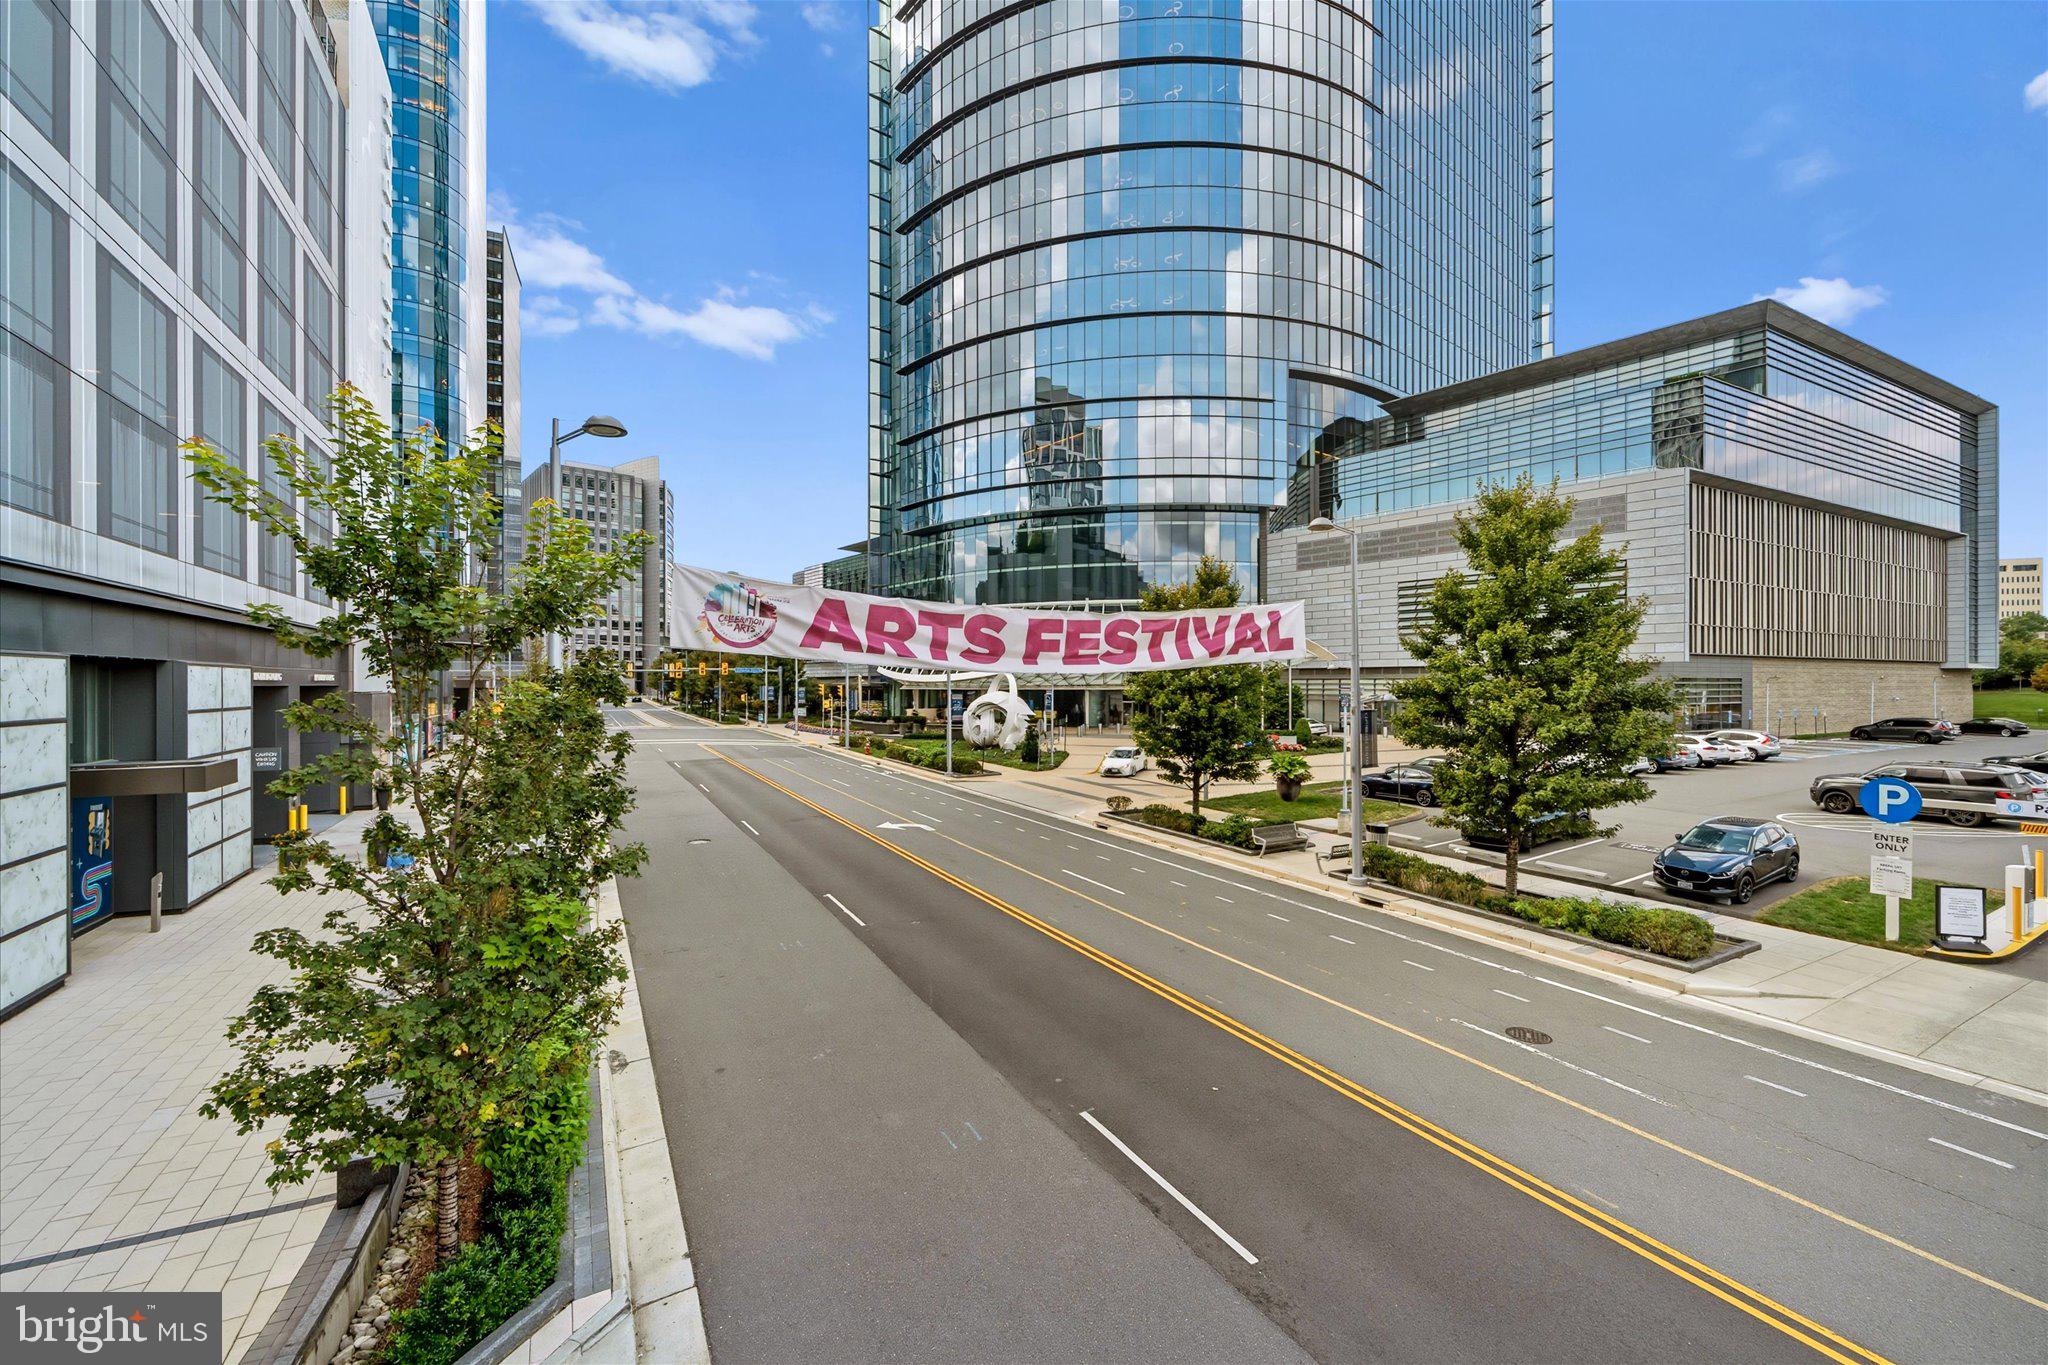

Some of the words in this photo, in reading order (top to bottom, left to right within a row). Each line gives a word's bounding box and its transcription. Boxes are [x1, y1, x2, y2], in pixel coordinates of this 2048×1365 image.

[733, 623, 756, 633] ARTS
[799, 598, 1007, 665] ARTS
[1022, 610, 1294, 665] FESTIVAL
[1879, 784, 1909, 815] P
[1874, 833, 1909, 844] ENTER
[1876, 842, 1907, 852] ONLY
